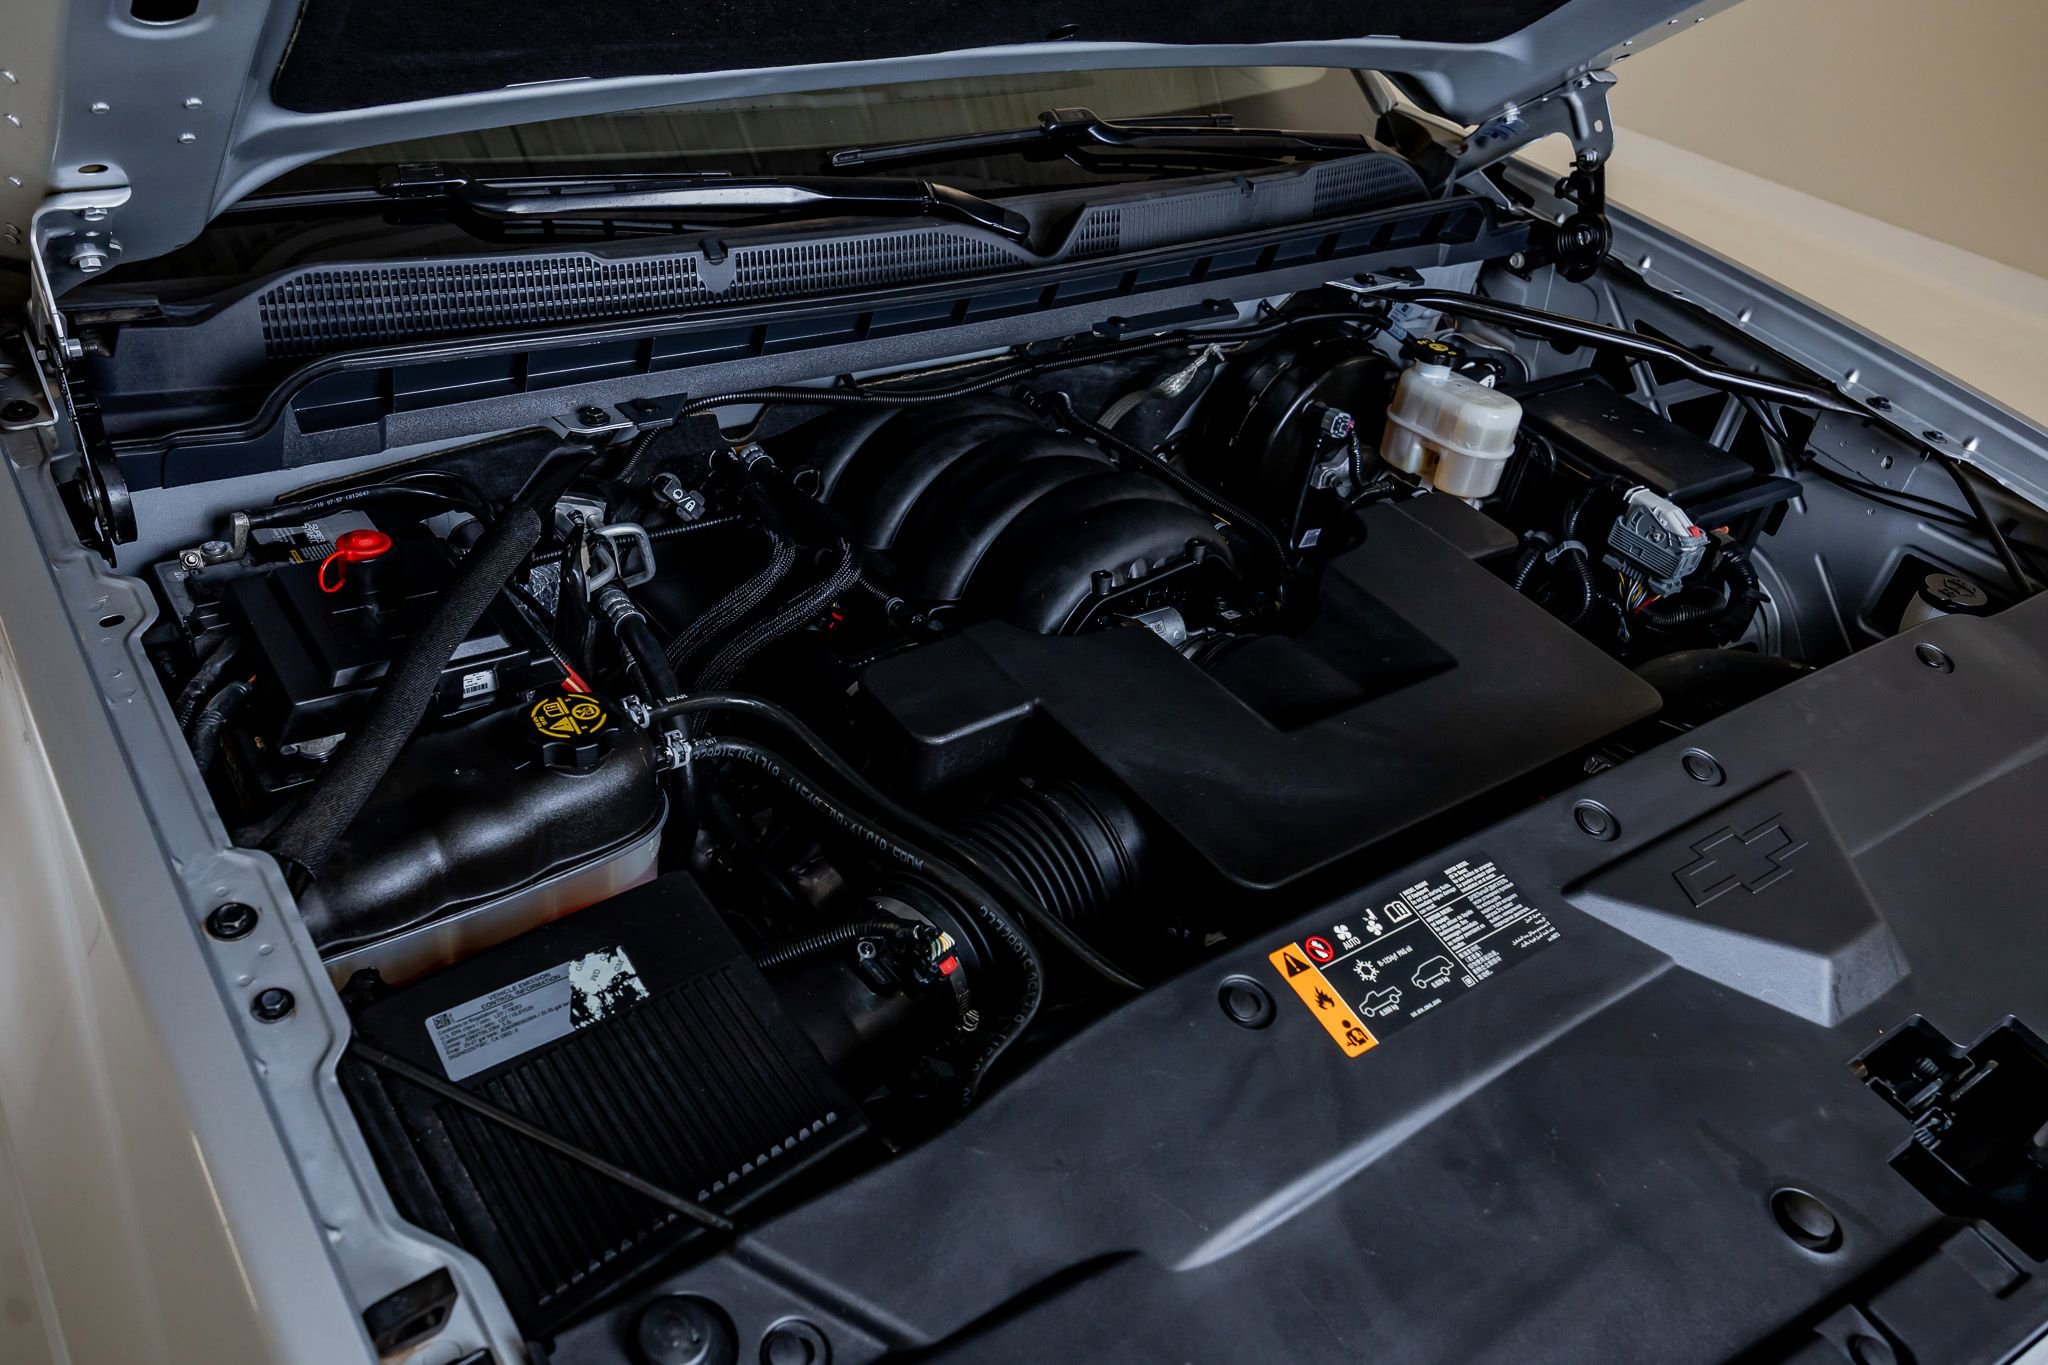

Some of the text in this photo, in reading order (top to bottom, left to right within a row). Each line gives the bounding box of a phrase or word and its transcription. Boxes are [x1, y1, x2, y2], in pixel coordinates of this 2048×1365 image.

[301, 521, 317, 544] START
[1341, 935, 1361, 950] AUTO
[480, 993, 512, 1009] CONTROL
[515, 973, 561, 995] INFORMATION
[487, 971, 551, 1001] VEHICLE EMISSION
